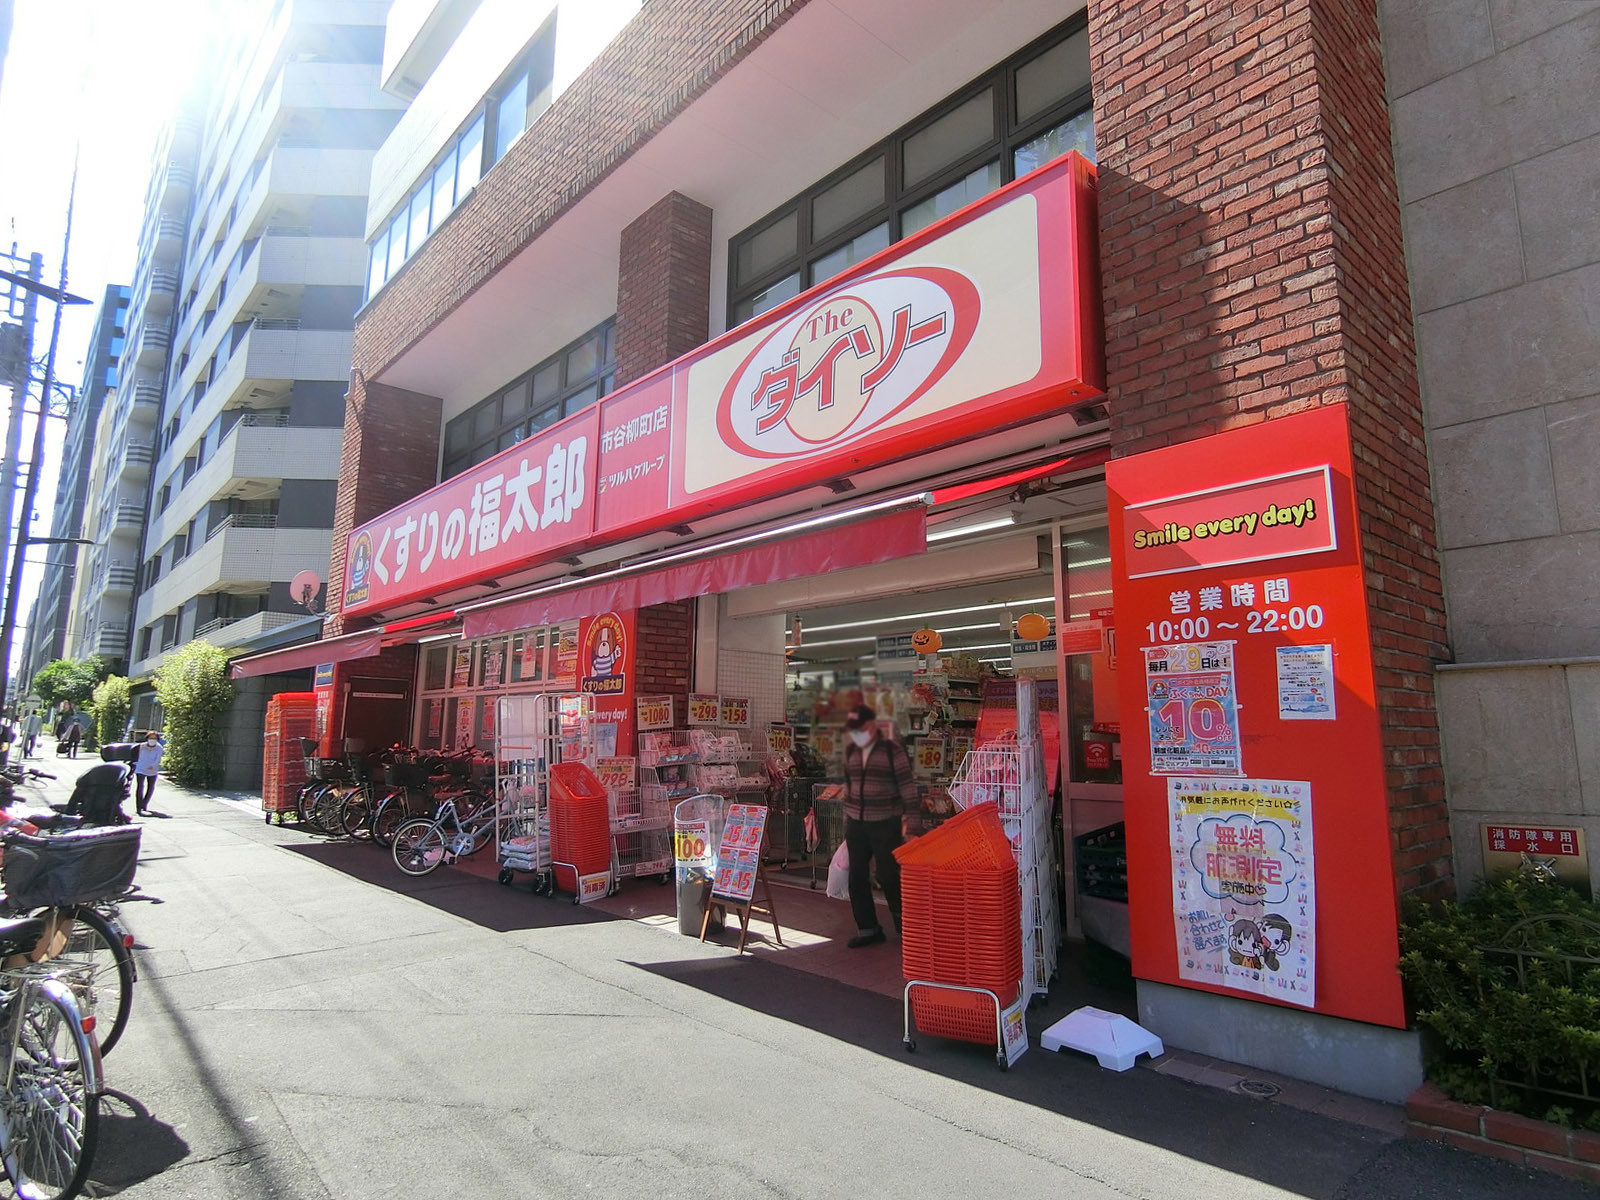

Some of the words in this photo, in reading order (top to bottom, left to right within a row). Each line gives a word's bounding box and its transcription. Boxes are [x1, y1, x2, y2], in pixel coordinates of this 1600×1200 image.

[806, 305, 854, 344] The
[751, 303, 947, 436] ダイソー
[601, 404, 668, 454] 市谷柳町店
[373, 435, 588, 586] くすりの福太郎
[1133, 523, 1191, 550] Smile
[1193, 512, 1258, 538] every
[1260, 498, 1316, 528] day!
[1169, 578, 1290, 615] 営業時間
[1215, 823, 1266, 853] 無料
[1493, 828, 1572, 843] 消防隊専用
